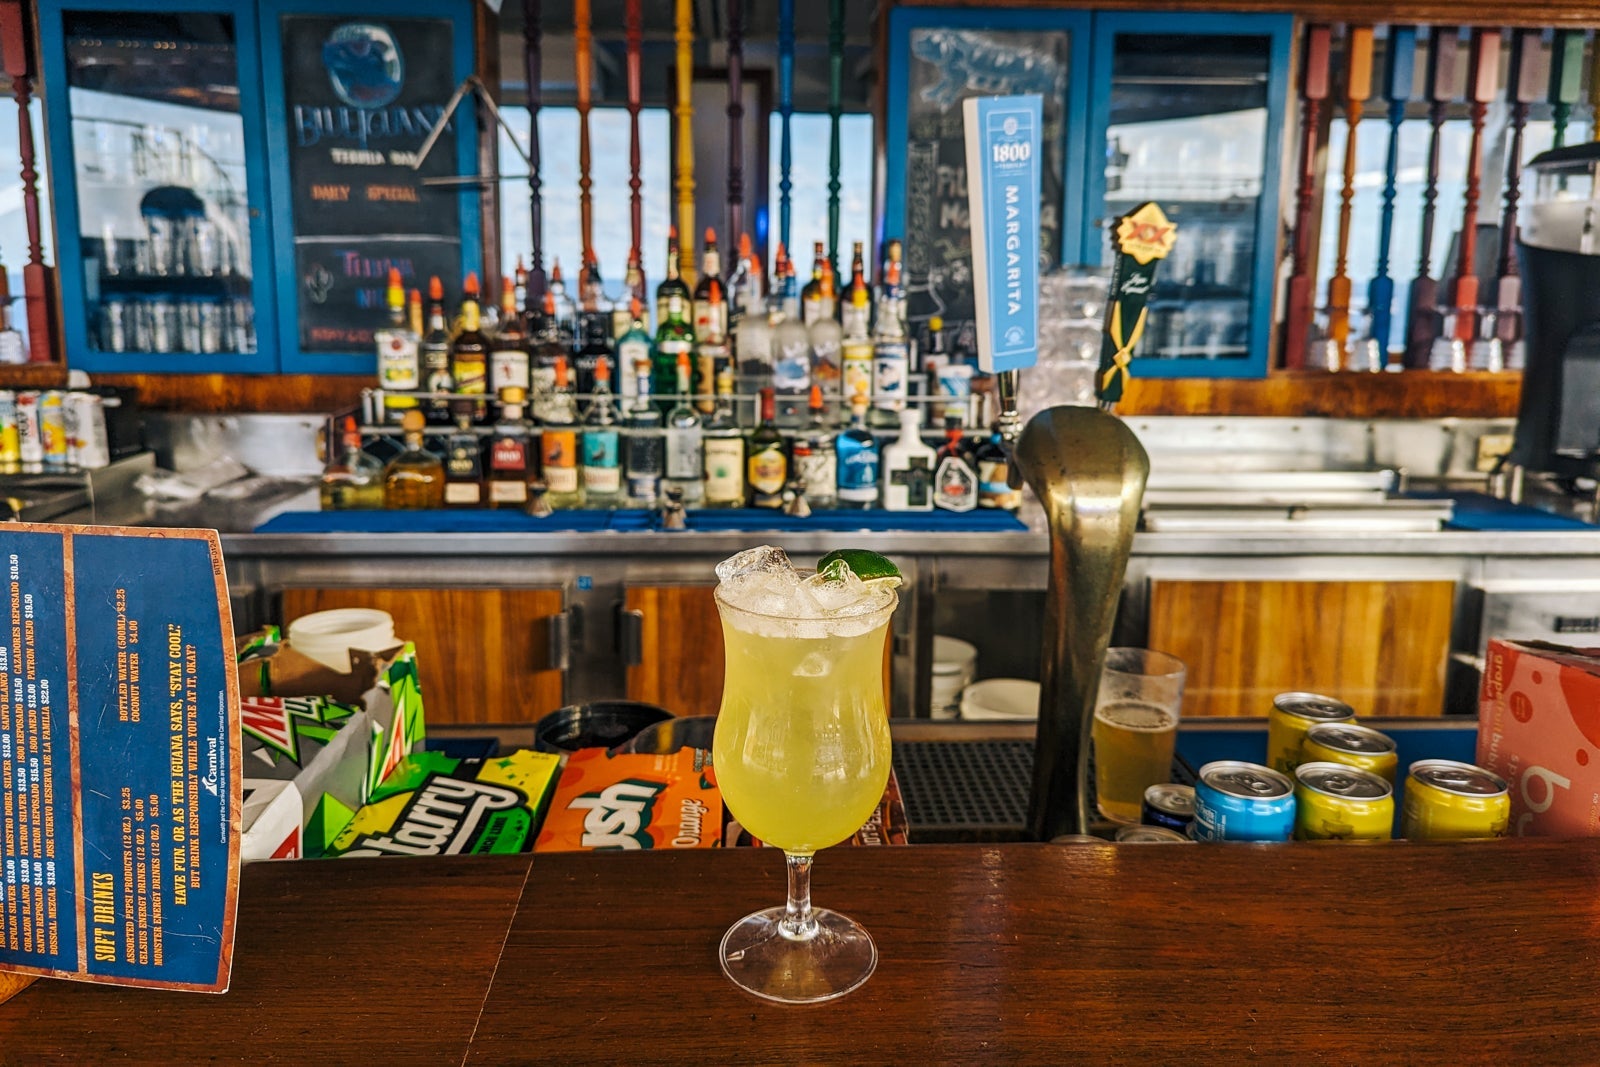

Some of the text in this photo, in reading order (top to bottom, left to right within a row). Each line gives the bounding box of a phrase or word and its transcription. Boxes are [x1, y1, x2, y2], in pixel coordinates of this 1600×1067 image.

[992, 141, 1030, 162] 1800
[1005, 185, 1021, 316] MARGARITA
[25, 594, 33, 618] $19.50
[26, 648, 35, 680] PATRON
[116, 589, 128, 721] BOTTLED WATER (500ML) $2.25
[128, 621, 140, 722] COCONUT WATER $4.00
[28, 684, 36, 708] $13.00
[170, 699, 183, 731] SAYS,
[10, 555, 32, 951] CORAZON BLANCO $13.00 PATRON SILVER $13.50 1800 REPOSADO $10.50 CAZADORES REPOSADO $10.50
[30, 758, 39, 782] $15.50
[171, 735, 183, 777] IGUANA
[186, 645, 200, 888] BUT DRINK RESPONSIBLY WHILE YOU'RE AT IT, OKAY?
[206, 738, 216, 783] Carnival
[0, 647, 18, 950] ESPOLON SILVER $13.00 MAESTRO DOBEL SILVER $13.00 SANTO BLANCO $13.00
[31, 784, 40, 825] REPOSADO
[171, 781, 184, 804] THE
[41, 680, 58, 955] BOSSCAL MEZCAL $13.00 JOSE CUERVO RESERVA DE LA FAMILIA $22.00
[173, 808, 184, 823] AS
[174, 826, 185, 841] OR
[672, 799, 708, 847] Orange
[33, 827, 41, 858] PATRON
[174, 846, 185, 871] FUN.
[34, 862, 42, 886] $14.00
[122, 788, 135, 963] ASSORTED PEPSI PRODUCTS (12 OZ.) $3.25
[135, 799, 148, 964] CELSIUS ENERGY DRINKS (12 OZ.) $5.00
[150, 795, 162, 965] MONSTER ENERGY DRINKS (12 OZ.) $5.00
[175, 875, 186, 905] HAVE
[35, 887, 44, 927] REPOSADO
[93, 873, 115, 961] SOFT DRINKS
[37, 928, 45, 953] SANTO
